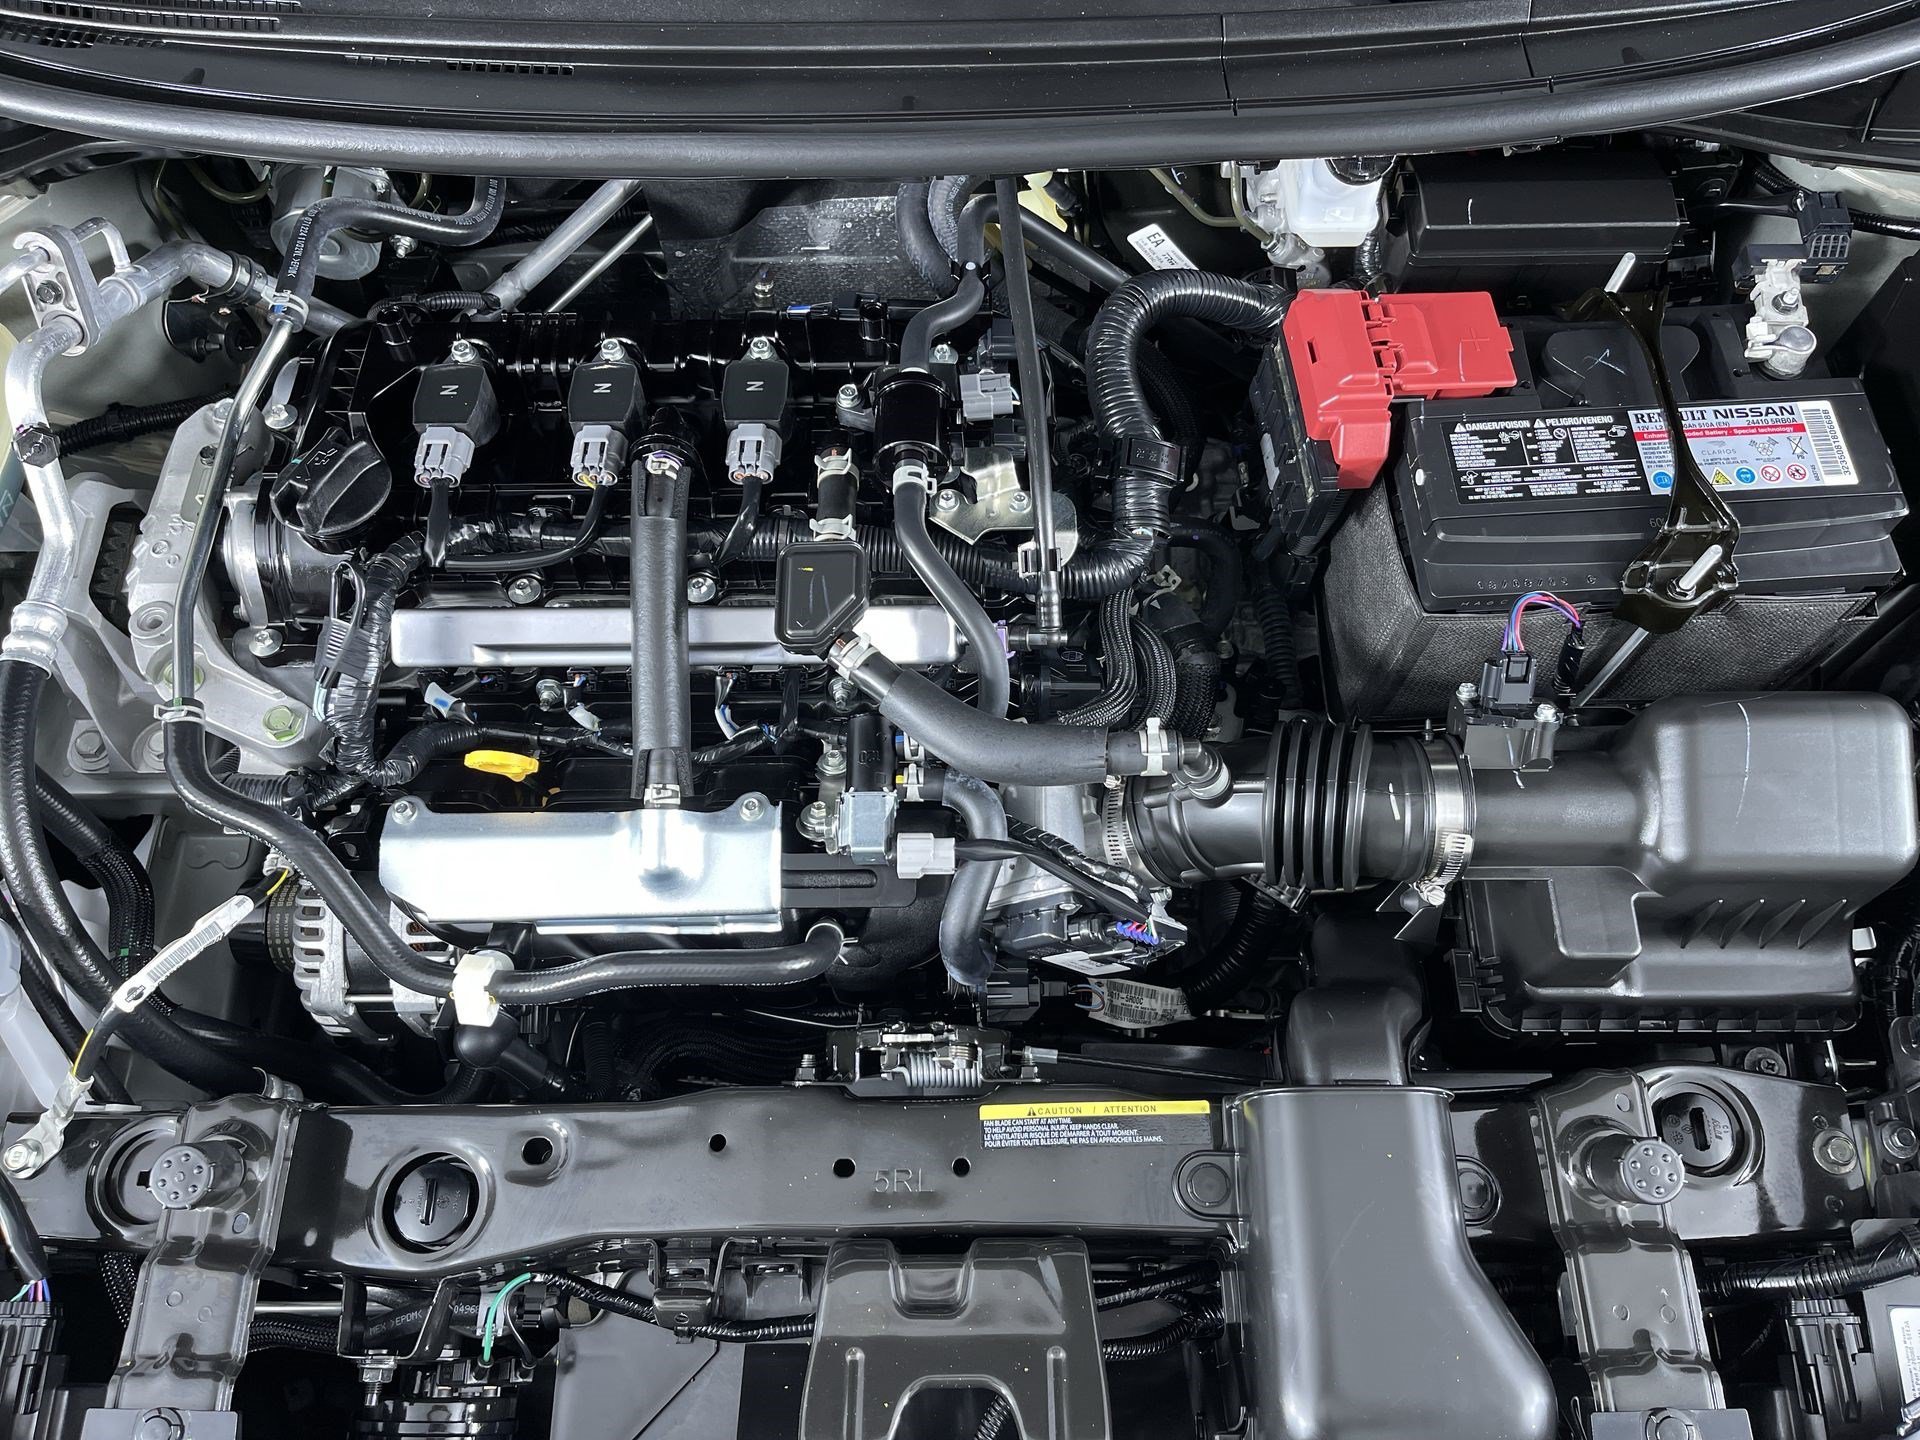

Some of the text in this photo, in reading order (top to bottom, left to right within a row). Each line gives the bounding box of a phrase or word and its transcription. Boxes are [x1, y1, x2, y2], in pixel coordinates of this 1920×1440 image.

[1147, 232, 1165, 248] EA
[1633, 405, 1795, 423] RENULT NISSAN
[1465, 420, 1530, 431] DANGER/POISON
[1545, 416, 1613, 428] PELIGRO/VENENO
[1758, 426, 1794, 434] technology
[1701, 448, 1737, 456] CLARIOS
[1037, 1106, 1082, 1115] CAUTION
[1104, 1105, 1157, 1114] ATTENTION
[995, 1119, 1011, 1127] BLADE
[1101, 1122, 1119, 1130] CLEAR.
[992, 1132, 1029, 1140] VENTILATEUR
[1029, 1131, 1050, 1139] RISQUE
[1060, 1129, 1091, 1138] DÉMARRER
[1040, 1138, 1070, 1146] BLESSURE,
